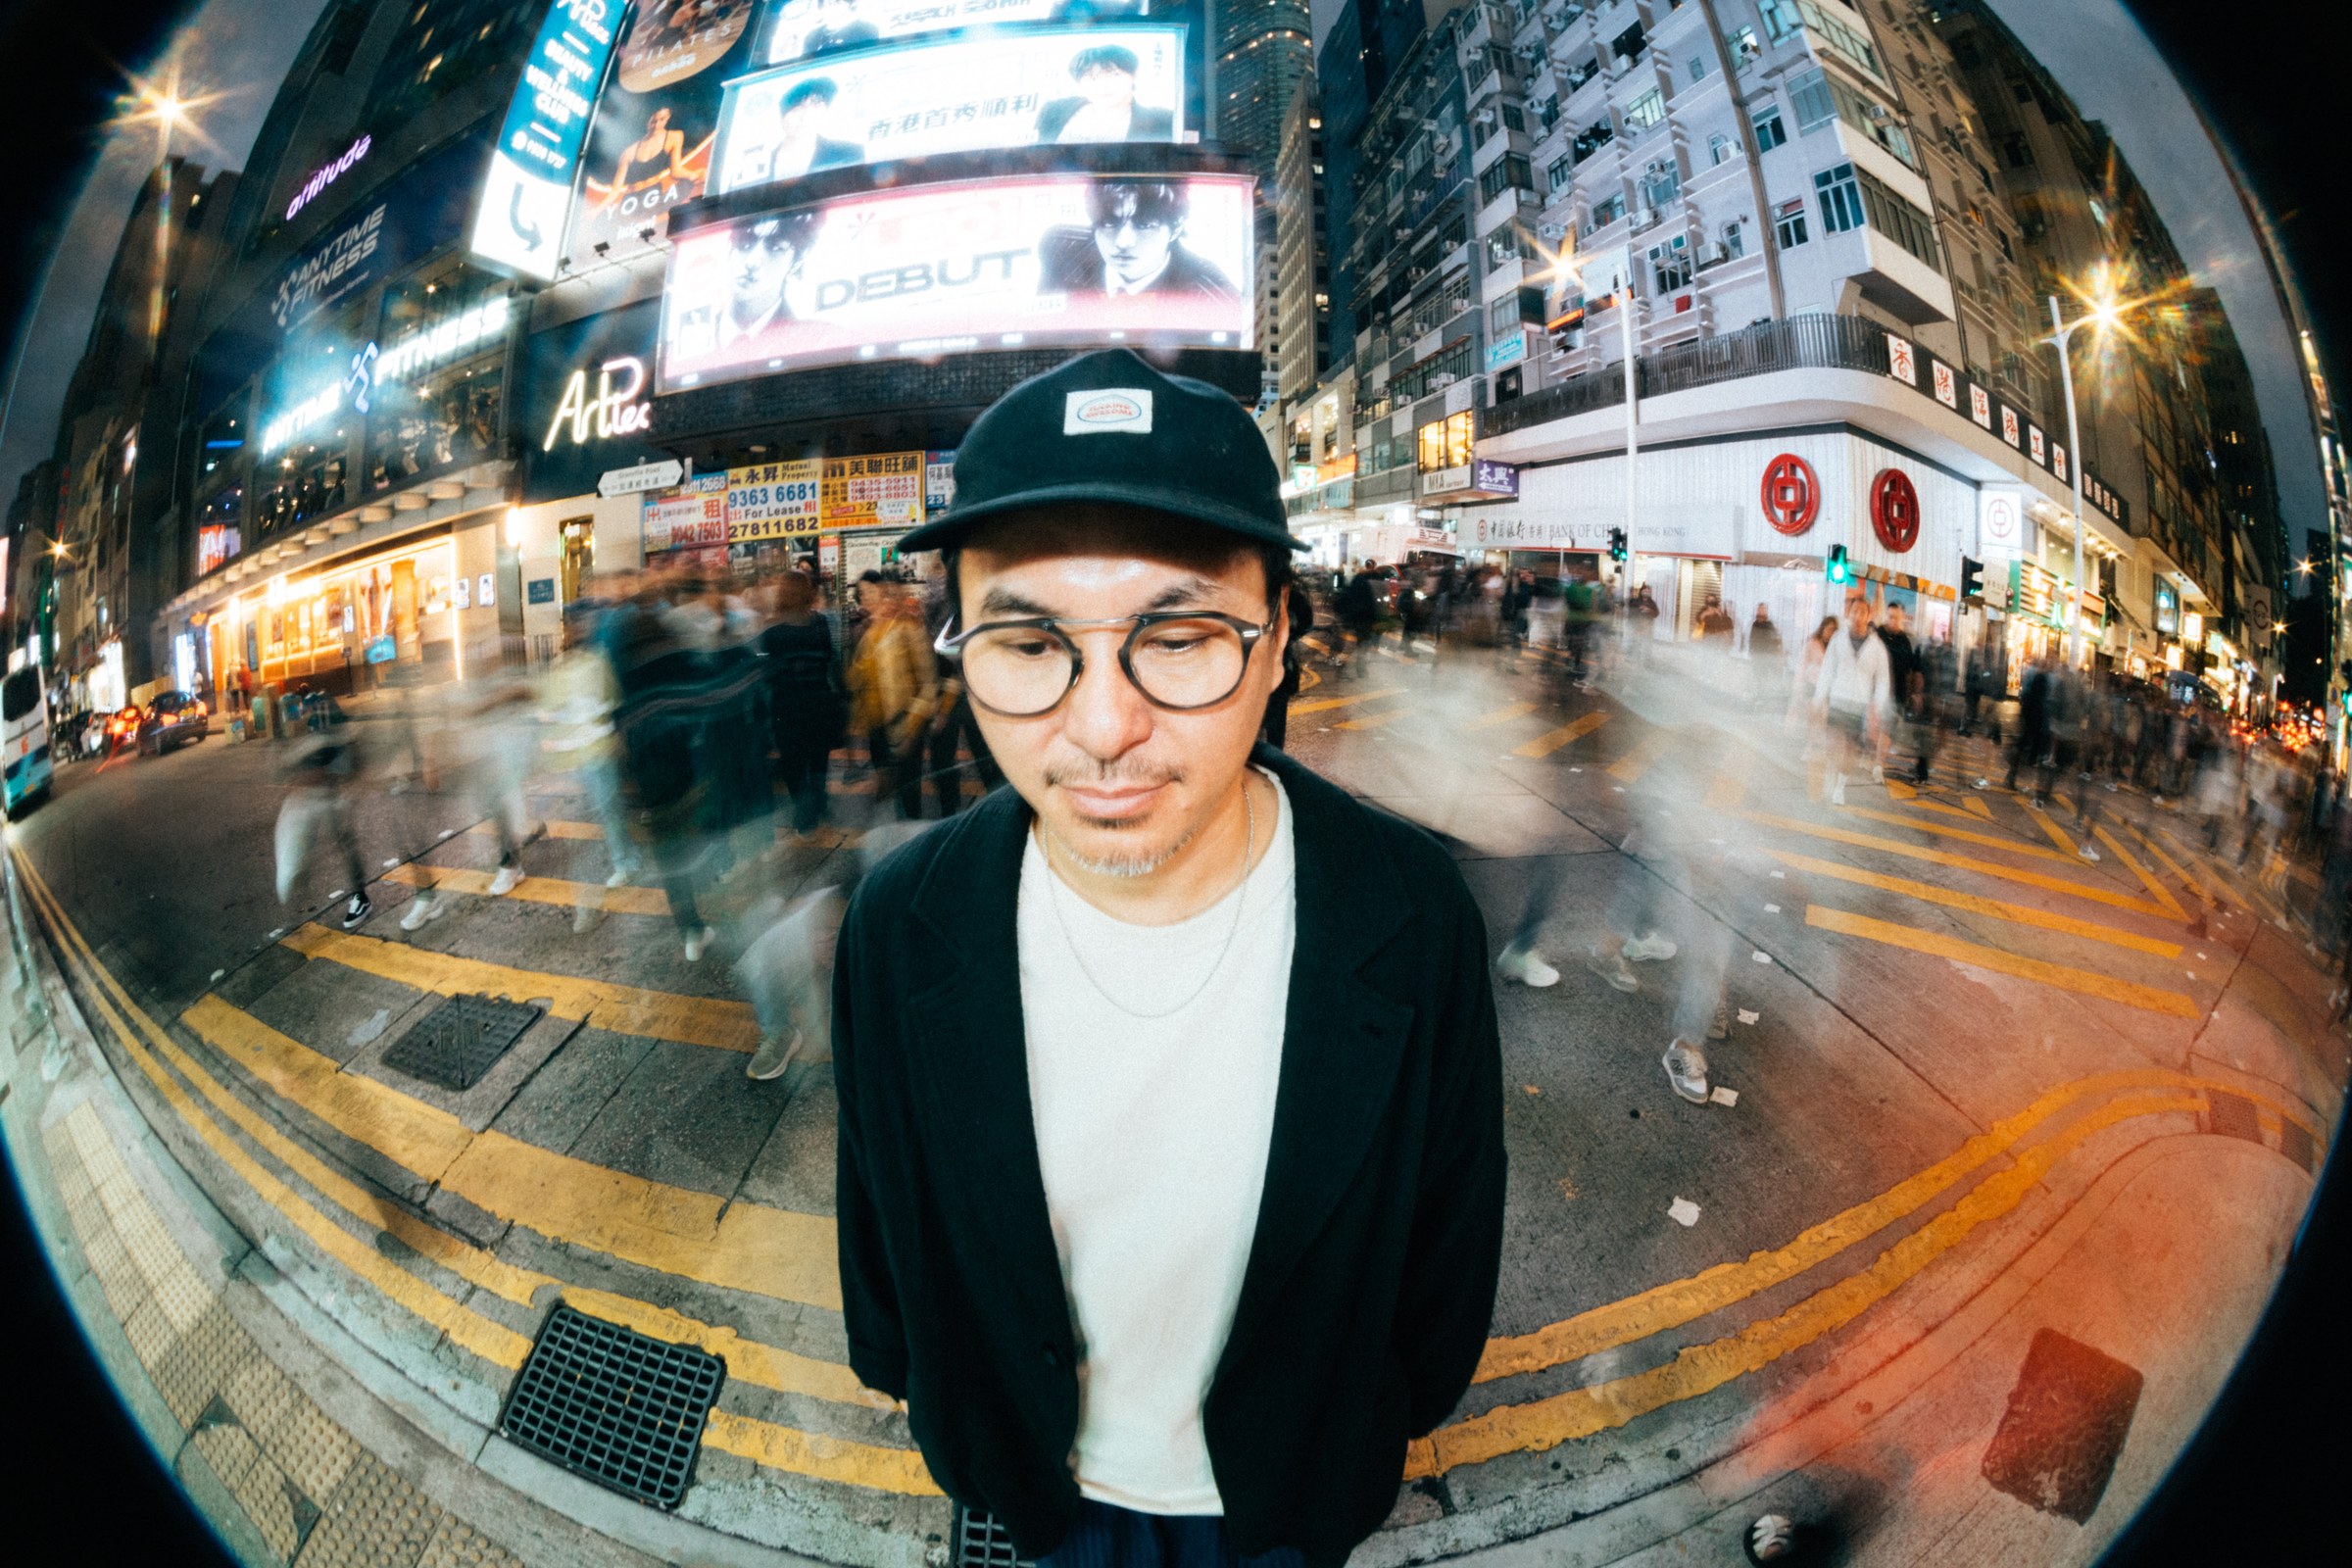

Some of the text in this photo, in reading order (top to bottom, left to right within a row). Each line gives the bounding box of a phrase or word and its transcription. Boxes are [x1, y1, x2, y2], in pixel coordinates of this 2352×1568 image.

[544, 38, 593, 82] BEAUTY
[633, 23, 732, 68] PILATES
[525, 64, 589, 118] WELLNESS
[535, 91, 570, 124] CLUB
[867, 93, 1040, 143] 香港首秀順利
[606, 184, 678, 220] YOGA
[296, 203, 387, 289] ANYTIME
[290, 228, 380, 314] FITNESS
[814, 248, 1032, 313] DEBUT
[374, 297, 509, 387] FITNESS
[782, 461, 811, 471] Mutual
[782, 470, 818, 480] Property
[704, 499, 721, 519] 租
[728, 486, 769, 509] 9363
[775, 481, 816, 503] 6681
[745, 508, 763, 519] For
[766, 505, 802, 517] Lease
[697, 521, 722, 540] 7503
[728, 516, 818, 538] 27811682
[1549, 524, 1575, 539] BANK
[1578, 524, 1592, 538] OF
